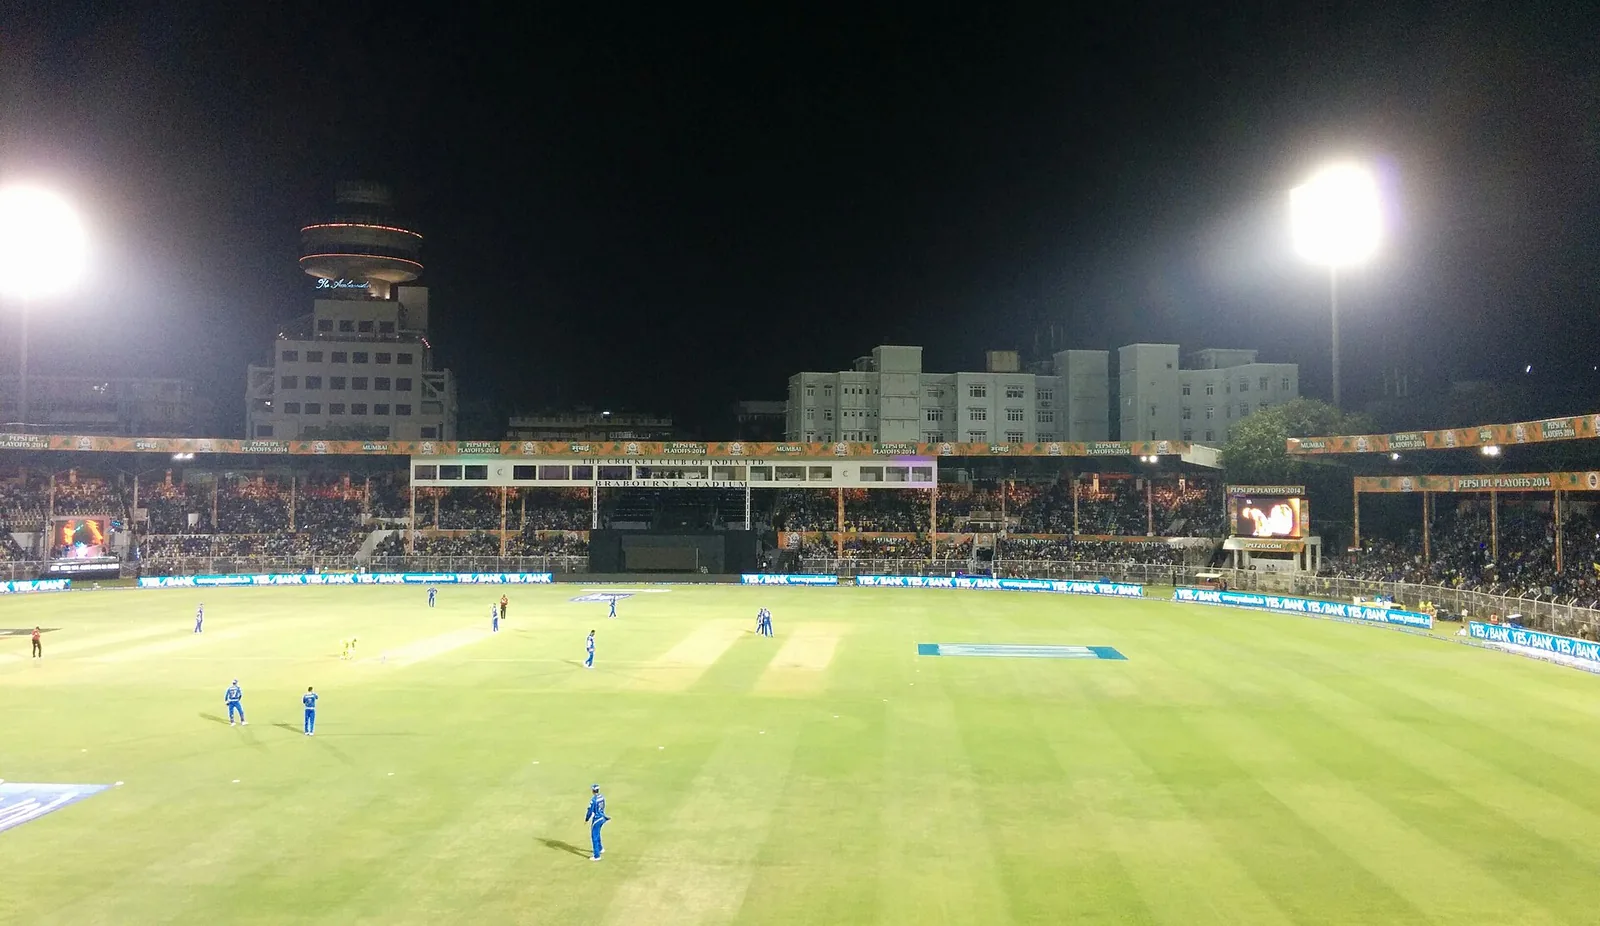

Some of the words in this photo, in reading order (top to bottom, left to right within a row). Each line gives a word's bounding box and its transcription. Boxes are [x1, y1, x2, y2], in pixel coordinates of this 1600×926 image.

[1300, 441, 1325, 449] MUMBAI
[595, 480, 679, 488] BRABOURNE
[686, 480, 748, 488] STADIUM
[1458, 479, 1479, 489] PEPSI
[1480, 478, 1492, 487] IPL
[1494, 478, 1531, 488] PLAYOFFS
[1532, 477, 1551, 487] 2014
